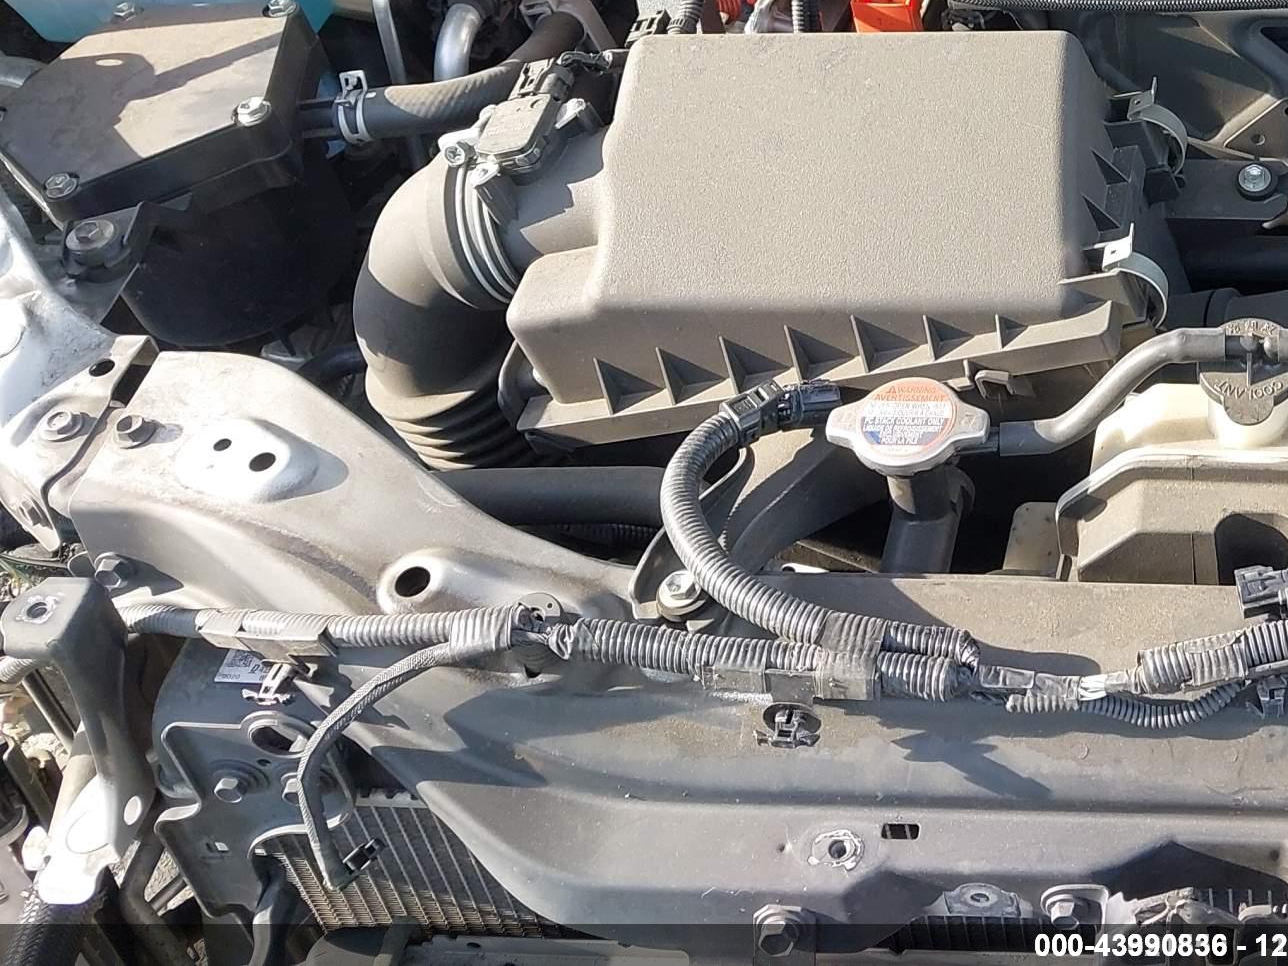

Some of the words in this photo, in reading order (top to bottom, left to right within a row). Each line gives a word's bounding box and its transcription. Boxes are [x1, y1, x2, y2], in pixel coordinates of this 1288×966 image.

[897, 386, 936, 394] WARNING
[1214, 380, 1284, 400] COOLANT
[875, 394, 946, 402] AVERTISSEMENT
[875, 417, 895, 425] STACK
[896, 417, 926, 426] COOLANT
[927, 417, 945, 426] ONLY
[896, 436, 905, 444] LA
[905, 436, 918, 444] PILE
